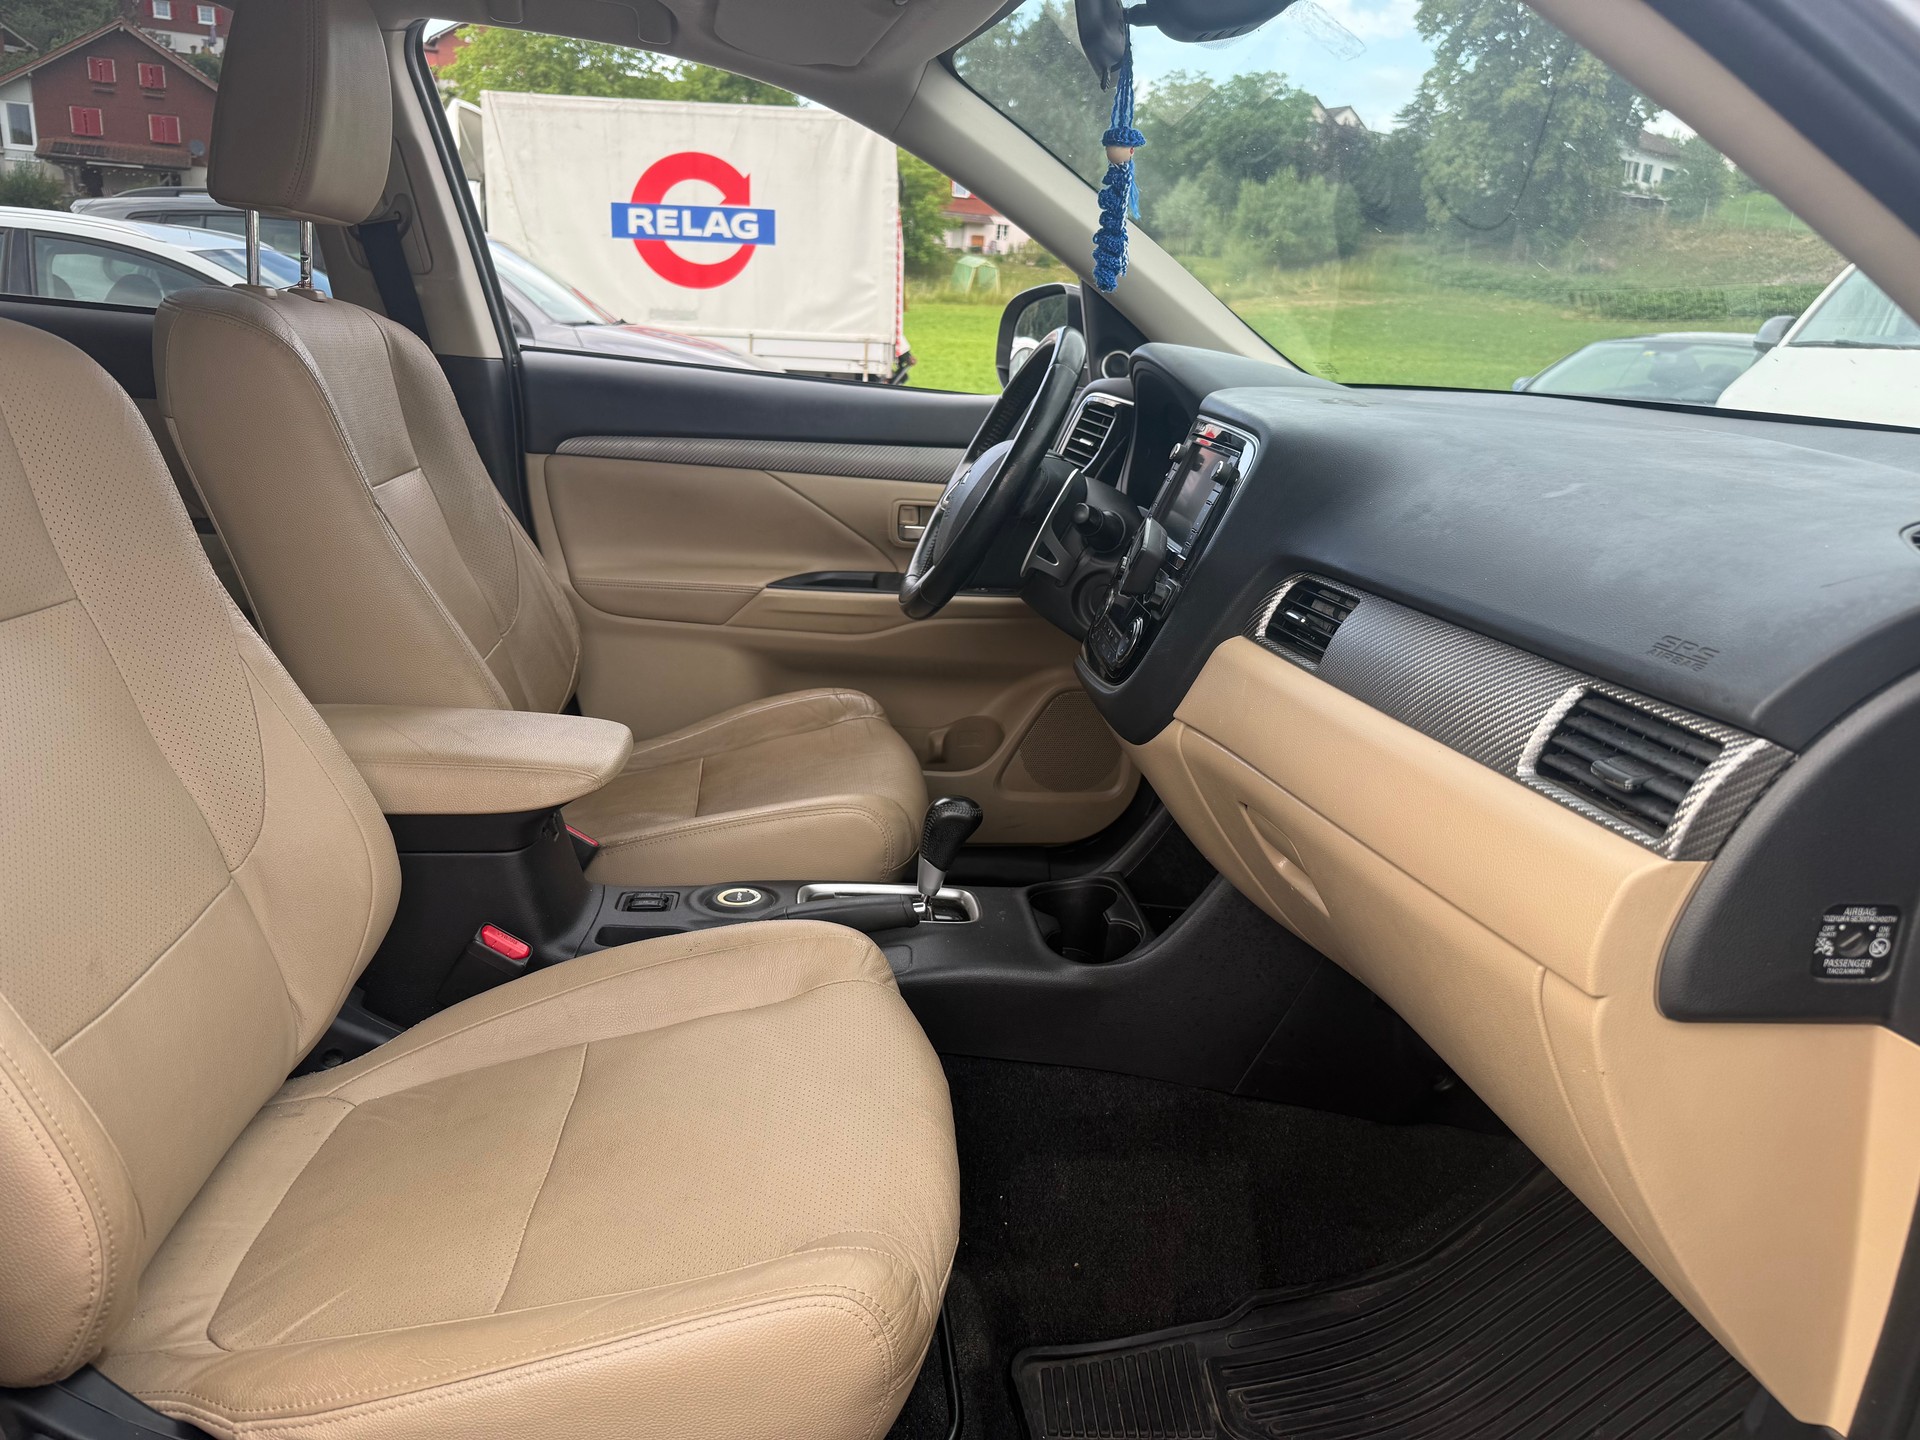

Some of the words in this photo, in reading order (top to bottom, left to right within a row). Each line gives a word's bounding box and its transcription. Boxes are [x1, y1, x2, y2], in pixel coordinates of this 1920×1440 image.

[627, 207, 760, 240] RELAG
[1843, 907, 1877, 916] AIRBAG
[1823, 958, 1873, 968] PASSENGER
